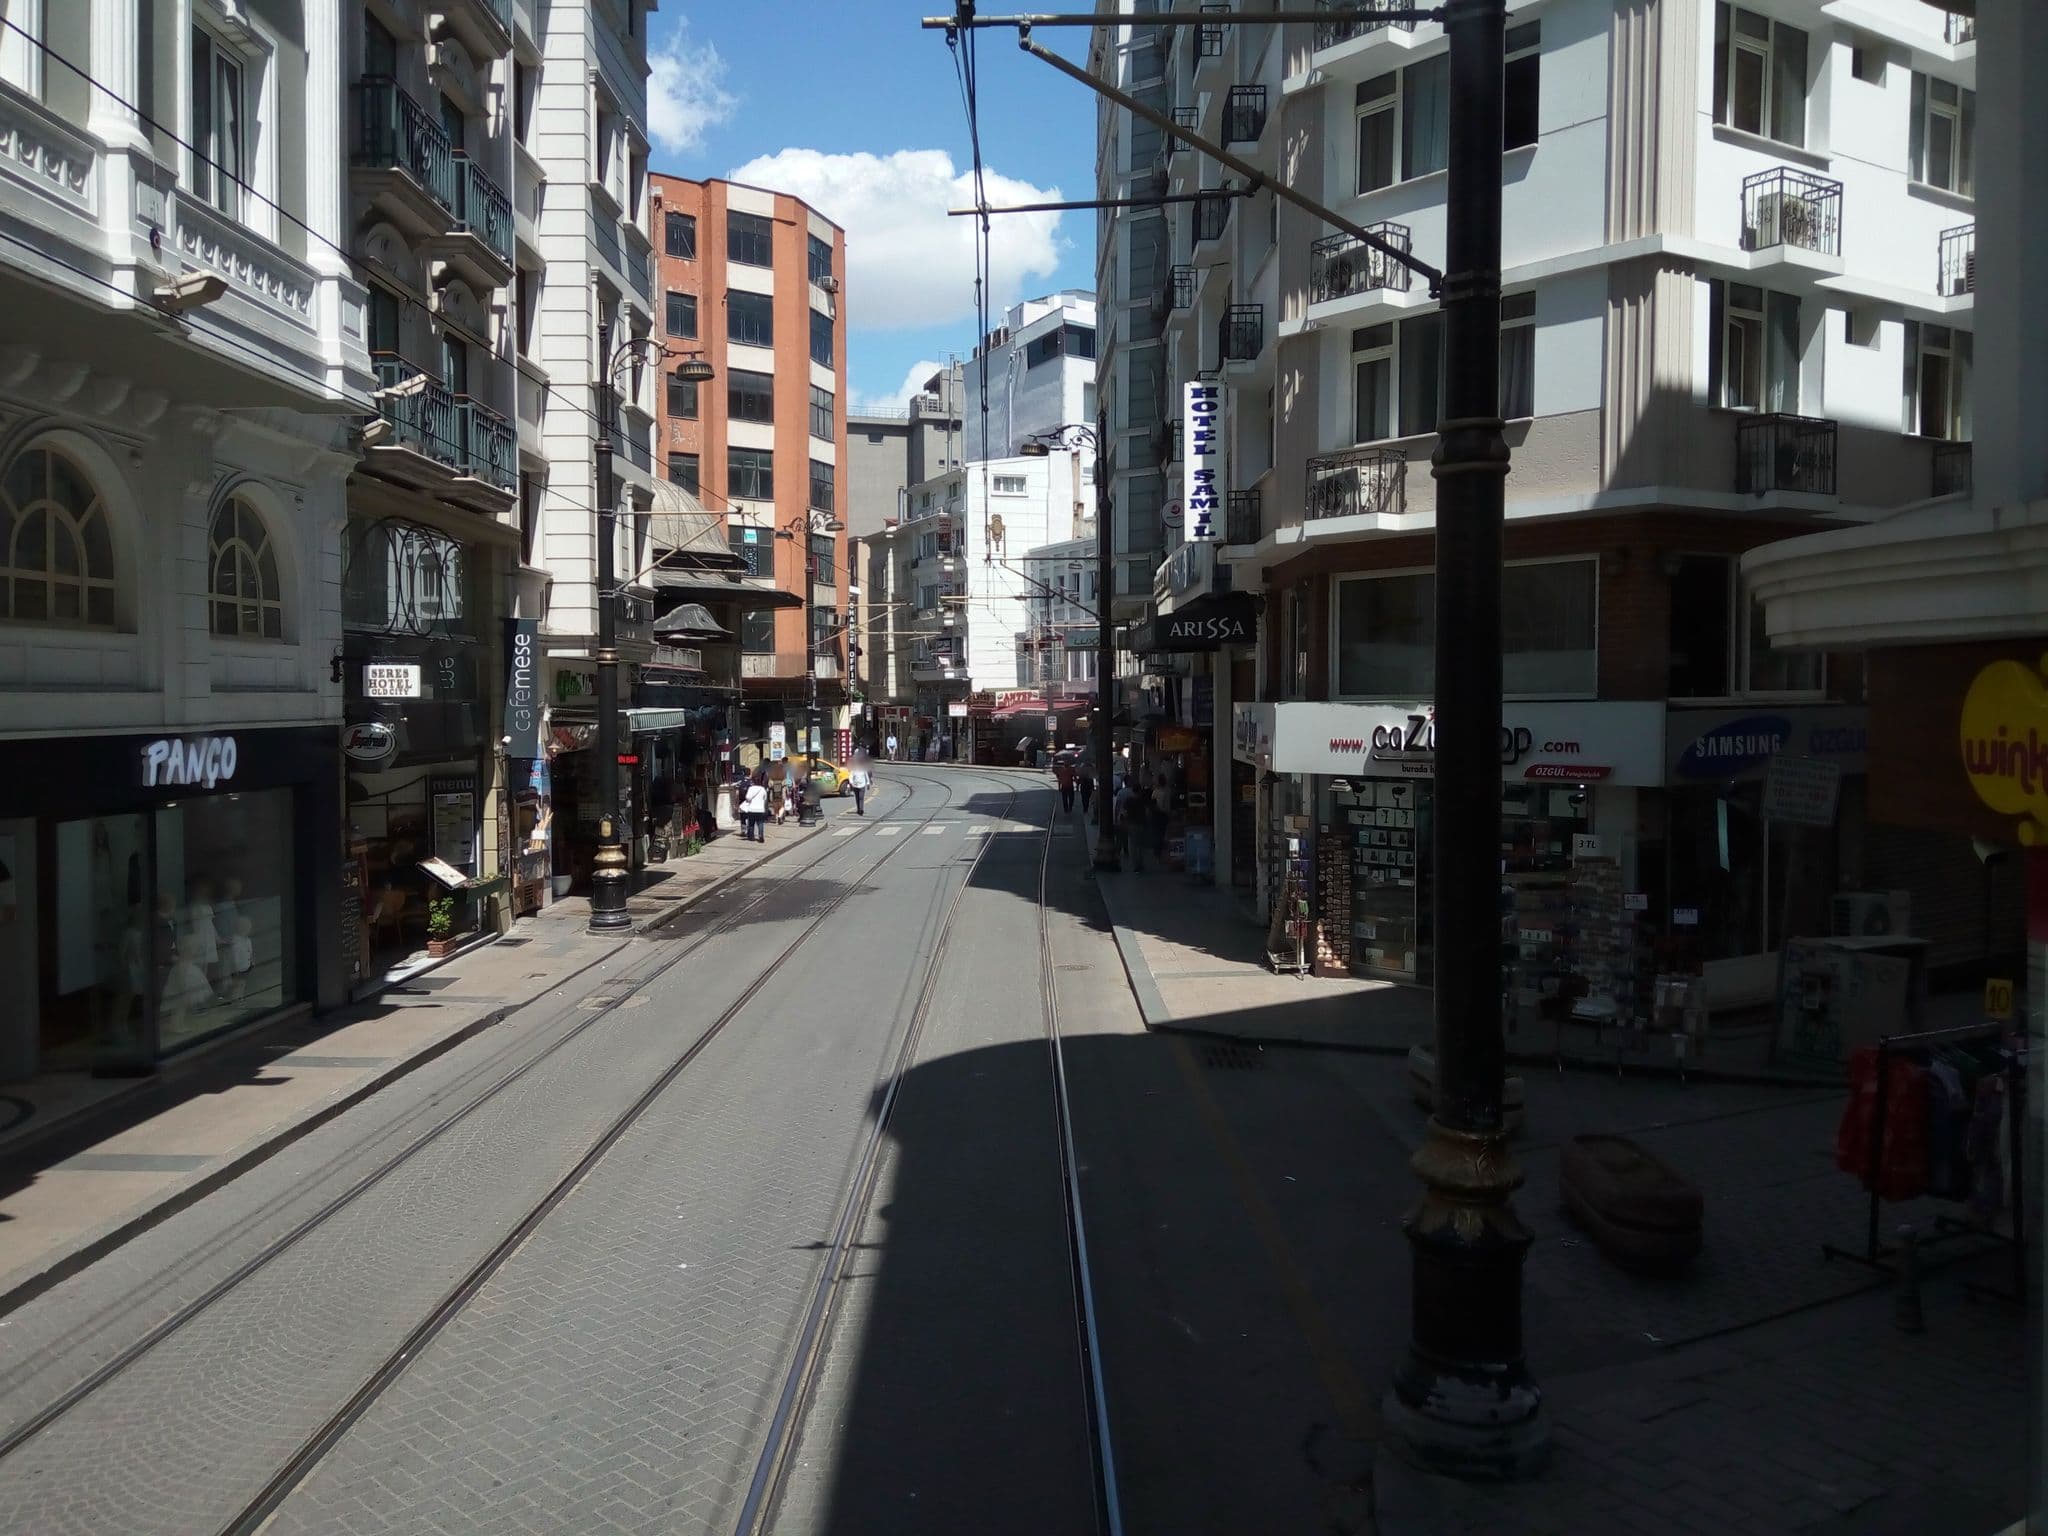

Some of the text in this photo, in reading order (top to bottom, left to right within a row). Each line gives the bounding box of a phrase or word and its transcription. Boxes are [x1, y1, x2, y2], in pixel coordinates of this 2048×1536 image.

[1189, 388, 1219, 537] HOTEL ŞAMİL
[1169, 616, 1245, 640] ARISSA
[371, 669, 409, 679] SERES
[368, 679, 412, 689] HOTEL
[371, 688, 409, 696] OLD CITY
[1539, 741, 1580, 753] .com
[1695, 733, 1783, 758] SAMSUNG
[142, 736, 237, 789] PANÇO
